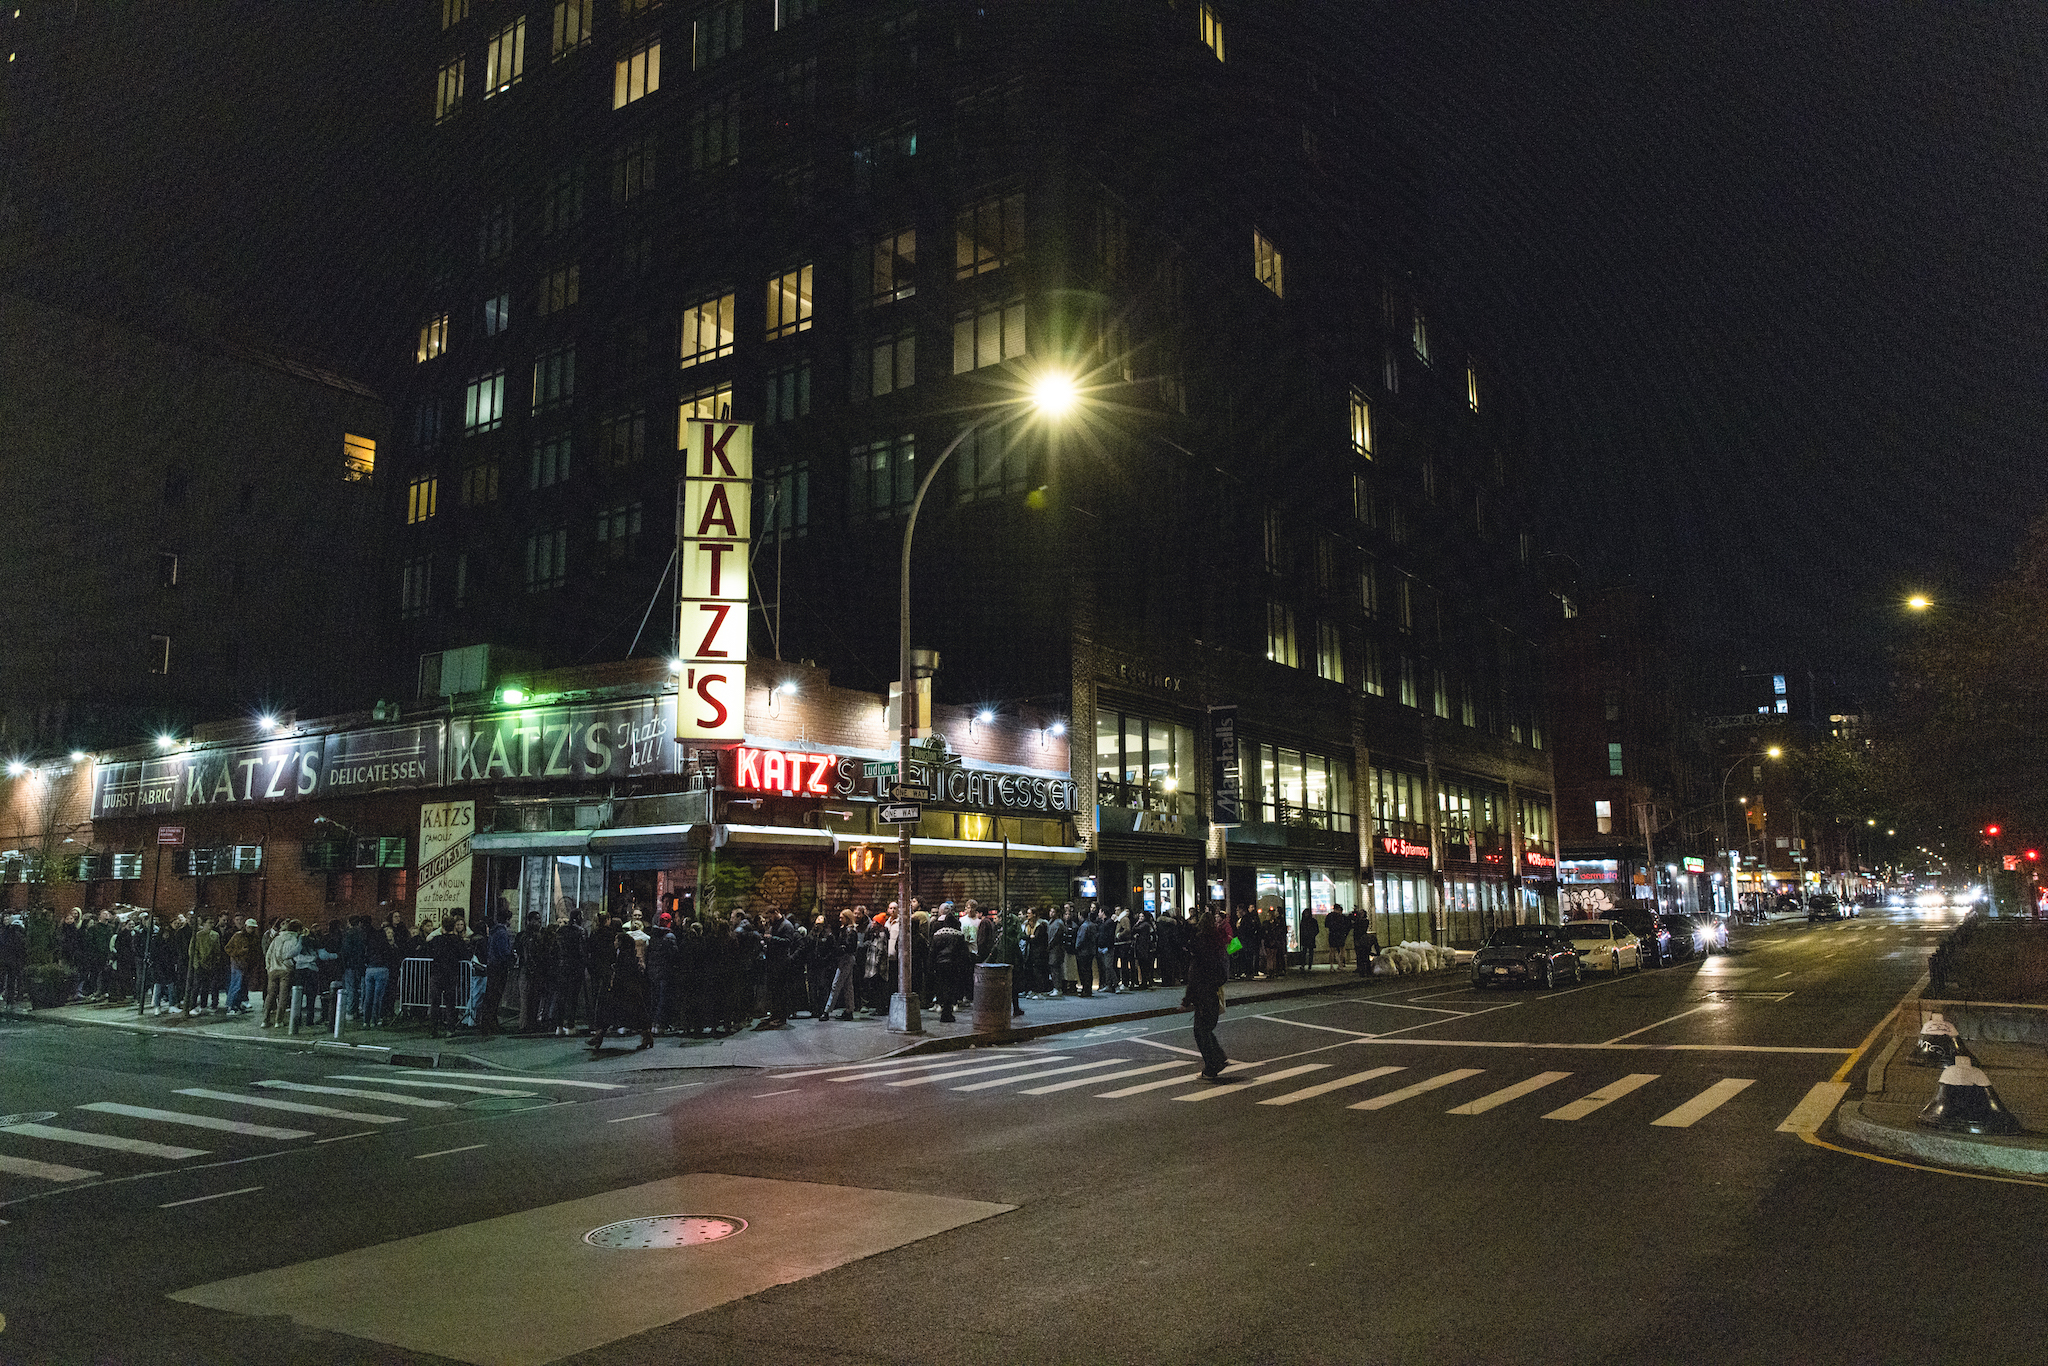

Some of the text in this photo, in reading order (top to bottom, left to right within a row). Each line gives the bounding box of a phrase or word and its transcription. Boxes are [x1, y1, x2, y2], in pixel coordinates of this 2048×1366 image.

[687, 424, 739, 729] KATZ'S
[617, 713, 668, 750] That's
[452, 721, 612, 781] KATZ'S
[184, 750, 319, 806] KATZ'S
[329, 759, 427, 786] DELICATESSEN
[737, 747, 856, 795] KATZ'S
[864, 762, 892, 776] Ludlow
[1215, 717, 1240, 821] Marshalls
[137, 787, 173, 805] FABRIC
[895, 788, 926, 798] ONE WAY
[423, 806, 472, 829] KATZ'S
[884, 808, 916, 818] ONE WAY
[420, 837, 471, 883] DELICATESSEN
[1405, 842, 1429, 860] pharmacy
[432, 889, 443, 902] the
[443, 889, 460, 902] Best
[438, 879, 465, 888] KNOWN
